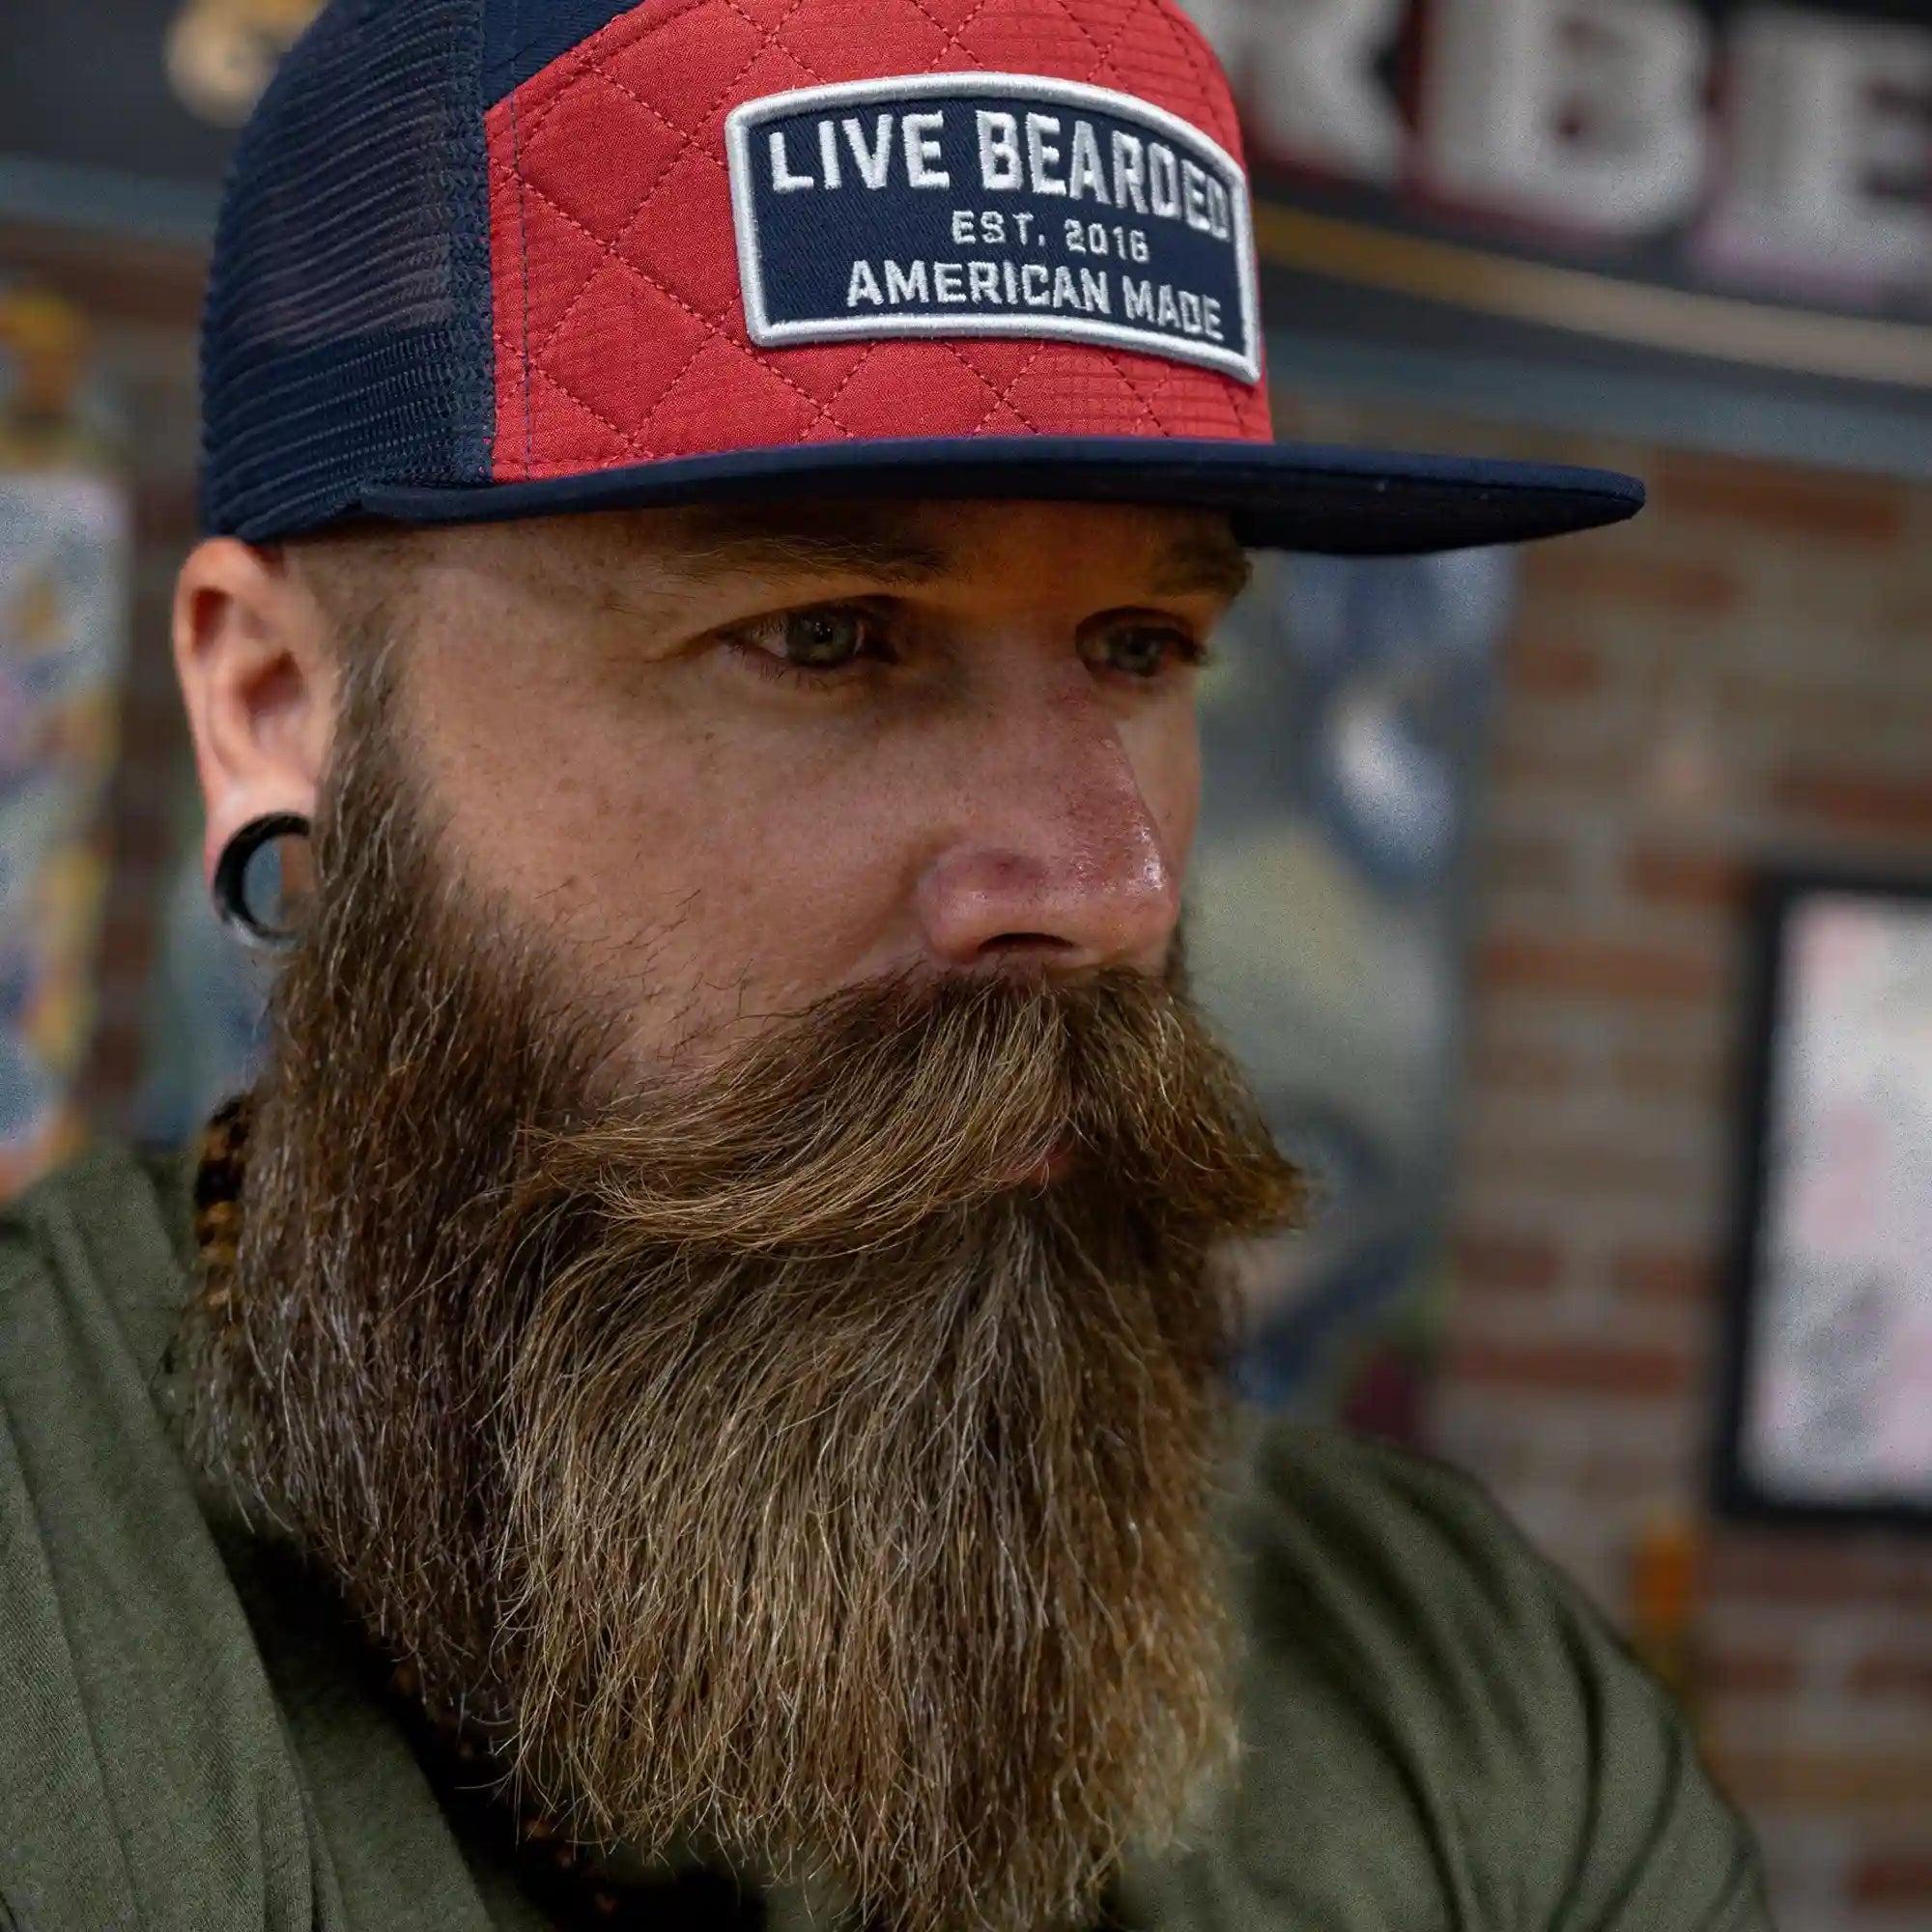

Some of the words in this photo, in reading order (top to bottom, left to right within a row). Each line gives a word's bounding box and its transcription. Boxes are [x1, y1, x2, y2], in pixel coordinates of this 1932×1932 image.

[769, 111, 951, 193] LIVE
[976, 109, 1232, 239] BEARDED
[952, 210, 1045, 245] EST.
[1065, 218, 1151, 263] 2016
[846, 259, 1111, 314] AMERICAN
[1122, 274, 1224, 339] MADE
